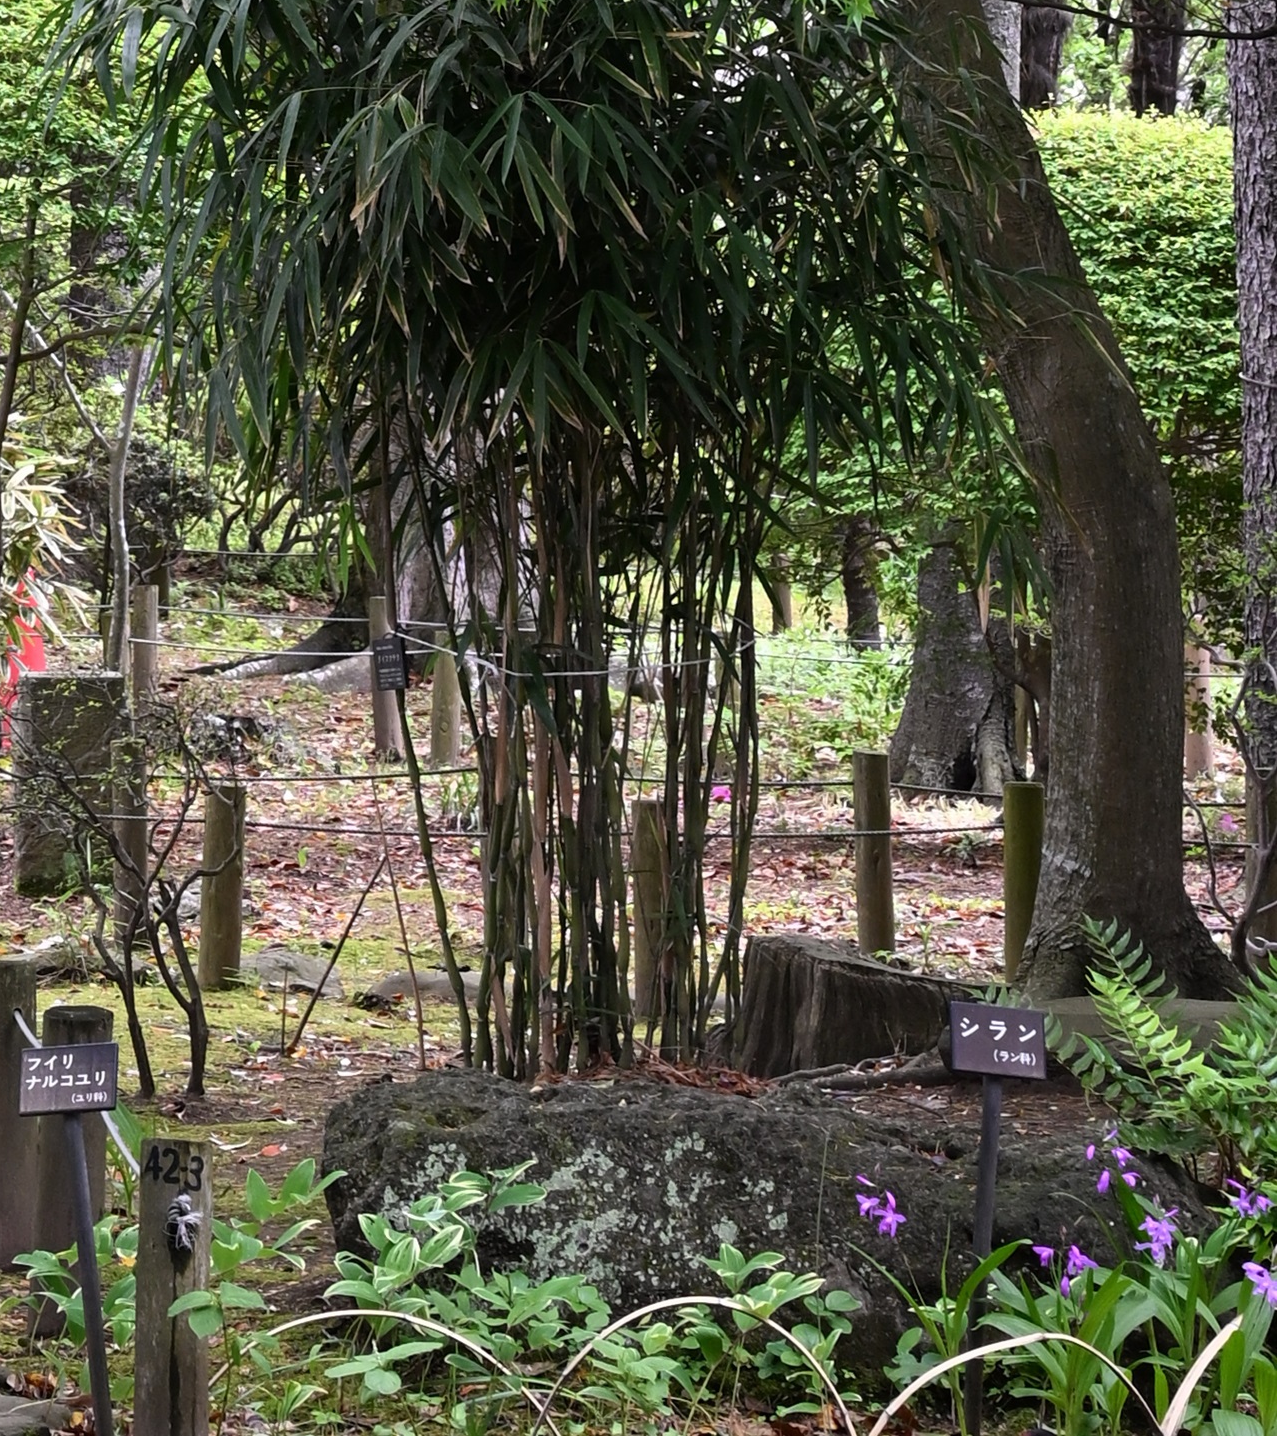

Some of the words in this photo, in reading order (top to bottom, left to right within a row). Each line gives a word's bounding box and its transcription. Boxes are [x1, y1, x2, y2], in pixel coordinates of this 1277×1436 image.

[959, 1017, 1037, 1043] シラン
[27, 1054, 74, 1072] フイリ
[993, 1051, 1036, 1066] (ラン科)
[25, 1070, 107, 1090] ナルコユリ
[71, 1091, 108, 1103] (ユリ科)
[143, 1145, 204, 1192] 42-3
